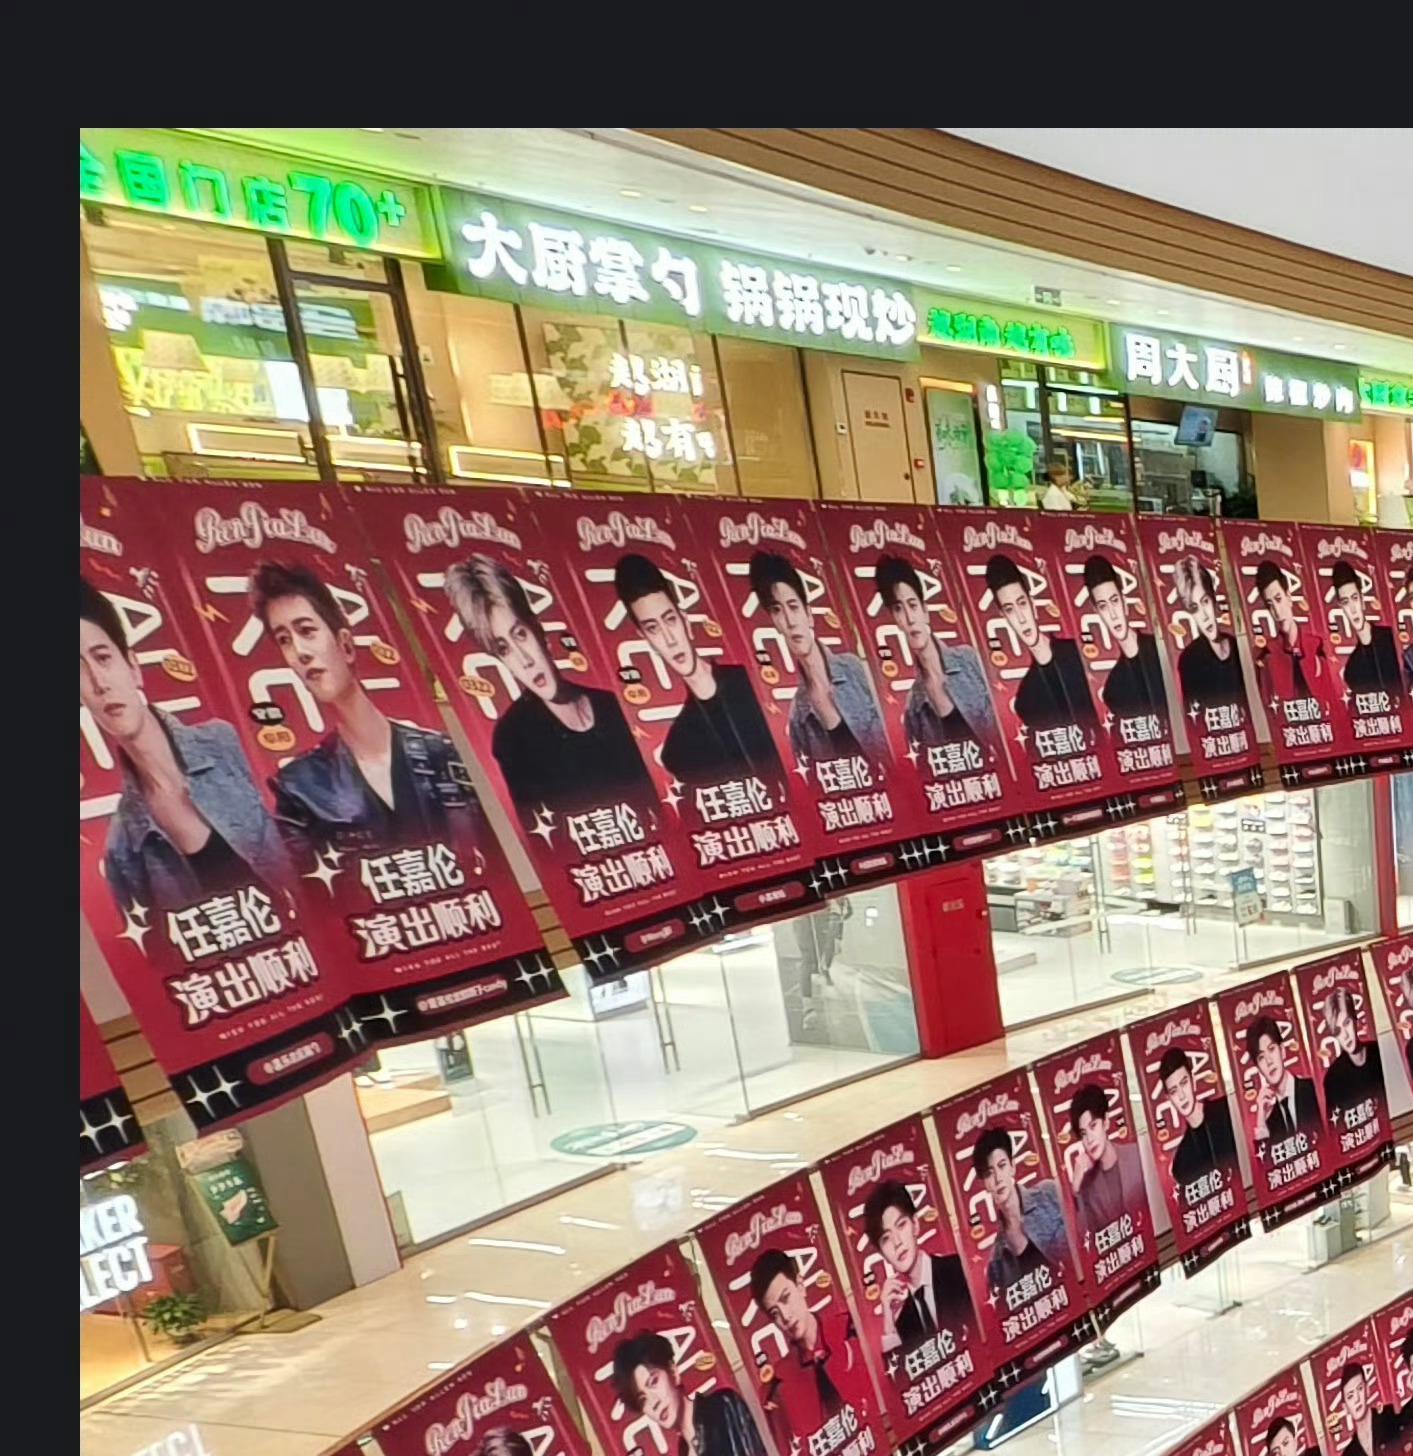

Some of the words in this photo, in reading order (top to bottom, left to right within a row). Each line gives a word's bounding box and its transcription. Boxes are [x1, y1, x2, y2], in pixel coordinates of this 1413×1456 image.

[461, 210, 698, 317] 大厨掌勺
[719, 259, 917, 345] 锅锅现炒
[1125, 333, 1241, 398] 周大厨
[1119, 714, 1162, 745] 任嘉伦
[815, 755, 873, 794] 任嘉伦
[926, 740, 983, 776] 任嘉伦
[1117, 743, 1174, 775] 演出顺利
[695, 776, 774, 824] 任嘉伦
[817, 791, 893, 832] 演出顺利
[925, 773, 1002, 812] 演出顺利
[566, 803, 644, 856] 任嘉伦
[691, 814, 800, 866] 演出顺利
[360, 842, 465, 903] 任嘉伦
[573, 845, 675, 904] 演出顺利
[167, 885, 282, 962] 任嘉伦
[354, 889, 502, 958] 演出顺利
[170, 935, 319, 1026] 演出顺利
[1267, 1153, 1322, 1191] 演出顺利
[1270, 1134, 1309, 1167] 任嘉伦
[1005, 1263, 1053, 1310] 任嘉伦
[1002, 1285, 1070, 1345] 演出顺利
